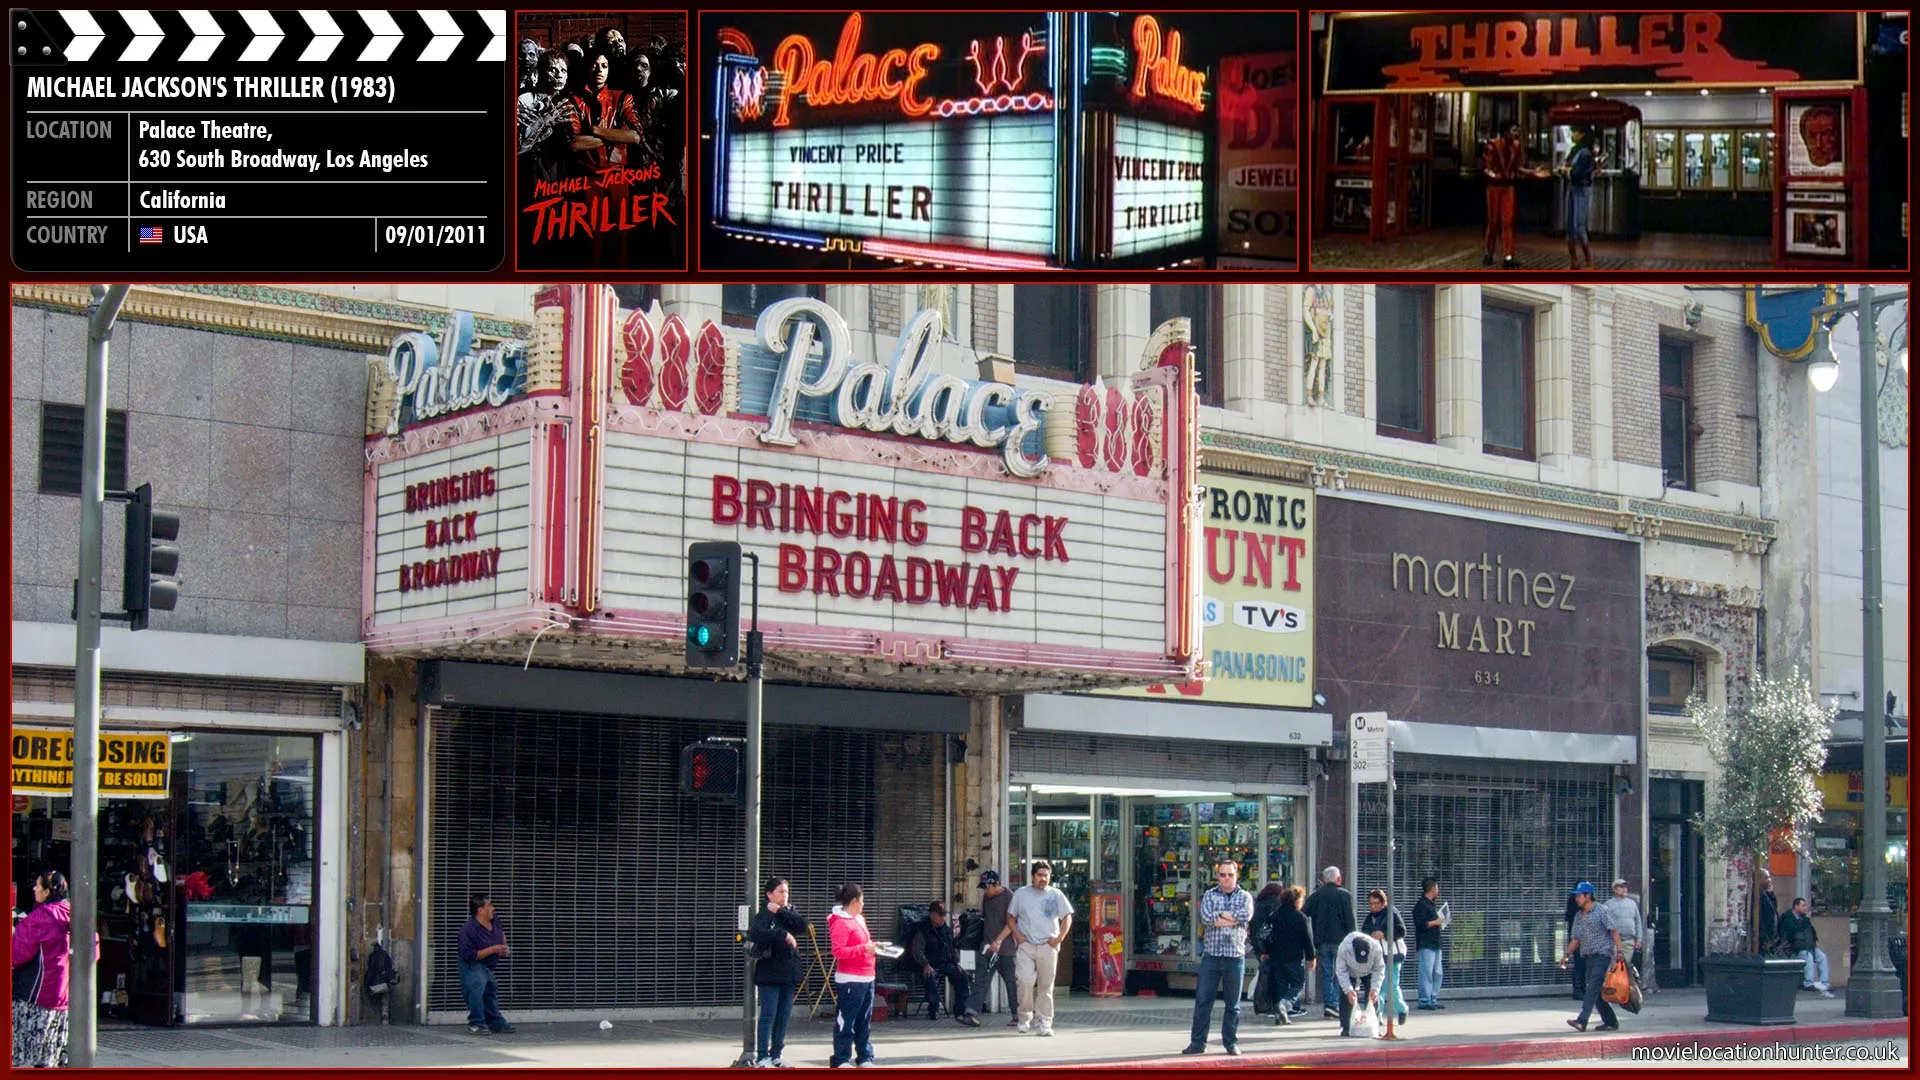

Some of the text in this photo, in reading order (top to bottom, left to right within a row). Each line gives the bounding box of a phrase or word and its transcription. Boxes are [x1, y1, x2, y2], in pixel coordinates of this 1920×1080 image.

[1410, 12, 1724, 68] THRILLER
[774, 12, 940, 126] Palace
[789, 143, 904, 164] VINCENT PRICE
[1114, 156, 1176, 181] VINCENT
[534, 161, 662, 198] MICHAEL JACKSON'S
[1235, 168, 1297, 187] JEWEL
[522, 193, 678, 245] THRILLER
[771, 181, 932, 222] THRILLER
[386, 310, 526, 435] Palace
[755, 297, 1055, 477] Palace
[405, 466, 496, 513] BRINGING
[425, 510, 478, 549] BACK
[712, 474, 1069, 562] BRINGING BACK
[399, 547, 501, 593] BROADWAY
[778, 542, 1020, 613] BROADWAY
[1393, 551, 1576, 611] martinez
[1242, 605, 1298, 629] TV'S
[1437, 610, 1536, 656] MART
[1212, 649, 1306, 684] PANASONIC
[1474, 670, 1500, 685] 634
[1352, 741, 1358, 749] 2
[1352, 751, 1358, 759] 4
[1352, 761, 1367, 769] 302
[105, 772, 121, 786] BE
[124, 773, 163, 787] SOLD!
